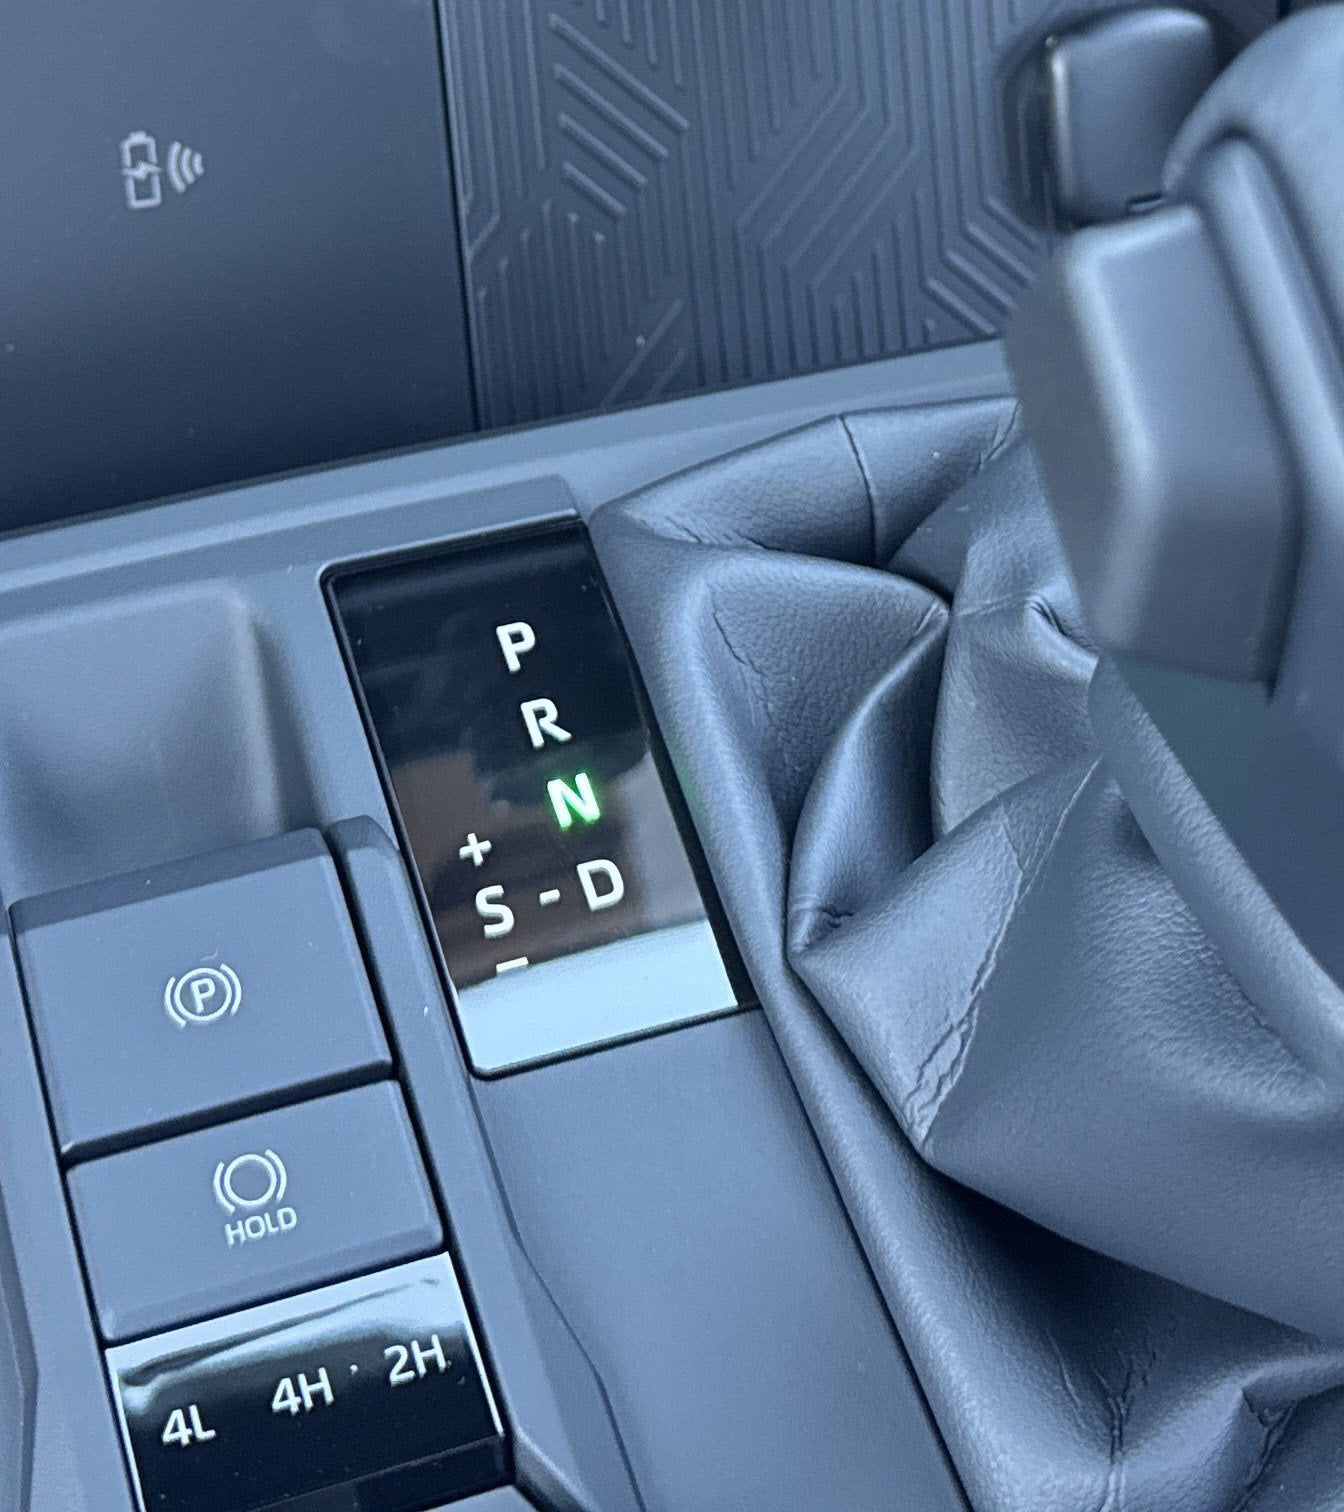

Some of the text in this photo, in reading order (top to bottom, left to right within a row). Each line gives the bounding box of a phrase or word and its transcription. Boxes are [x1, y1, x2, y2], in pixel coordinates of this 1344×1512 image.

[496, 621, 536, 672] P
[520, 698, 572, 748] R
[547, 772, 601, 828] N
[475, 884, 515, 938] S
[576, 859, 625, 911] D
[224, 1206, 298, 1245] HOLD
[162, 1335, 450, 1446] 4L 4H 2H
